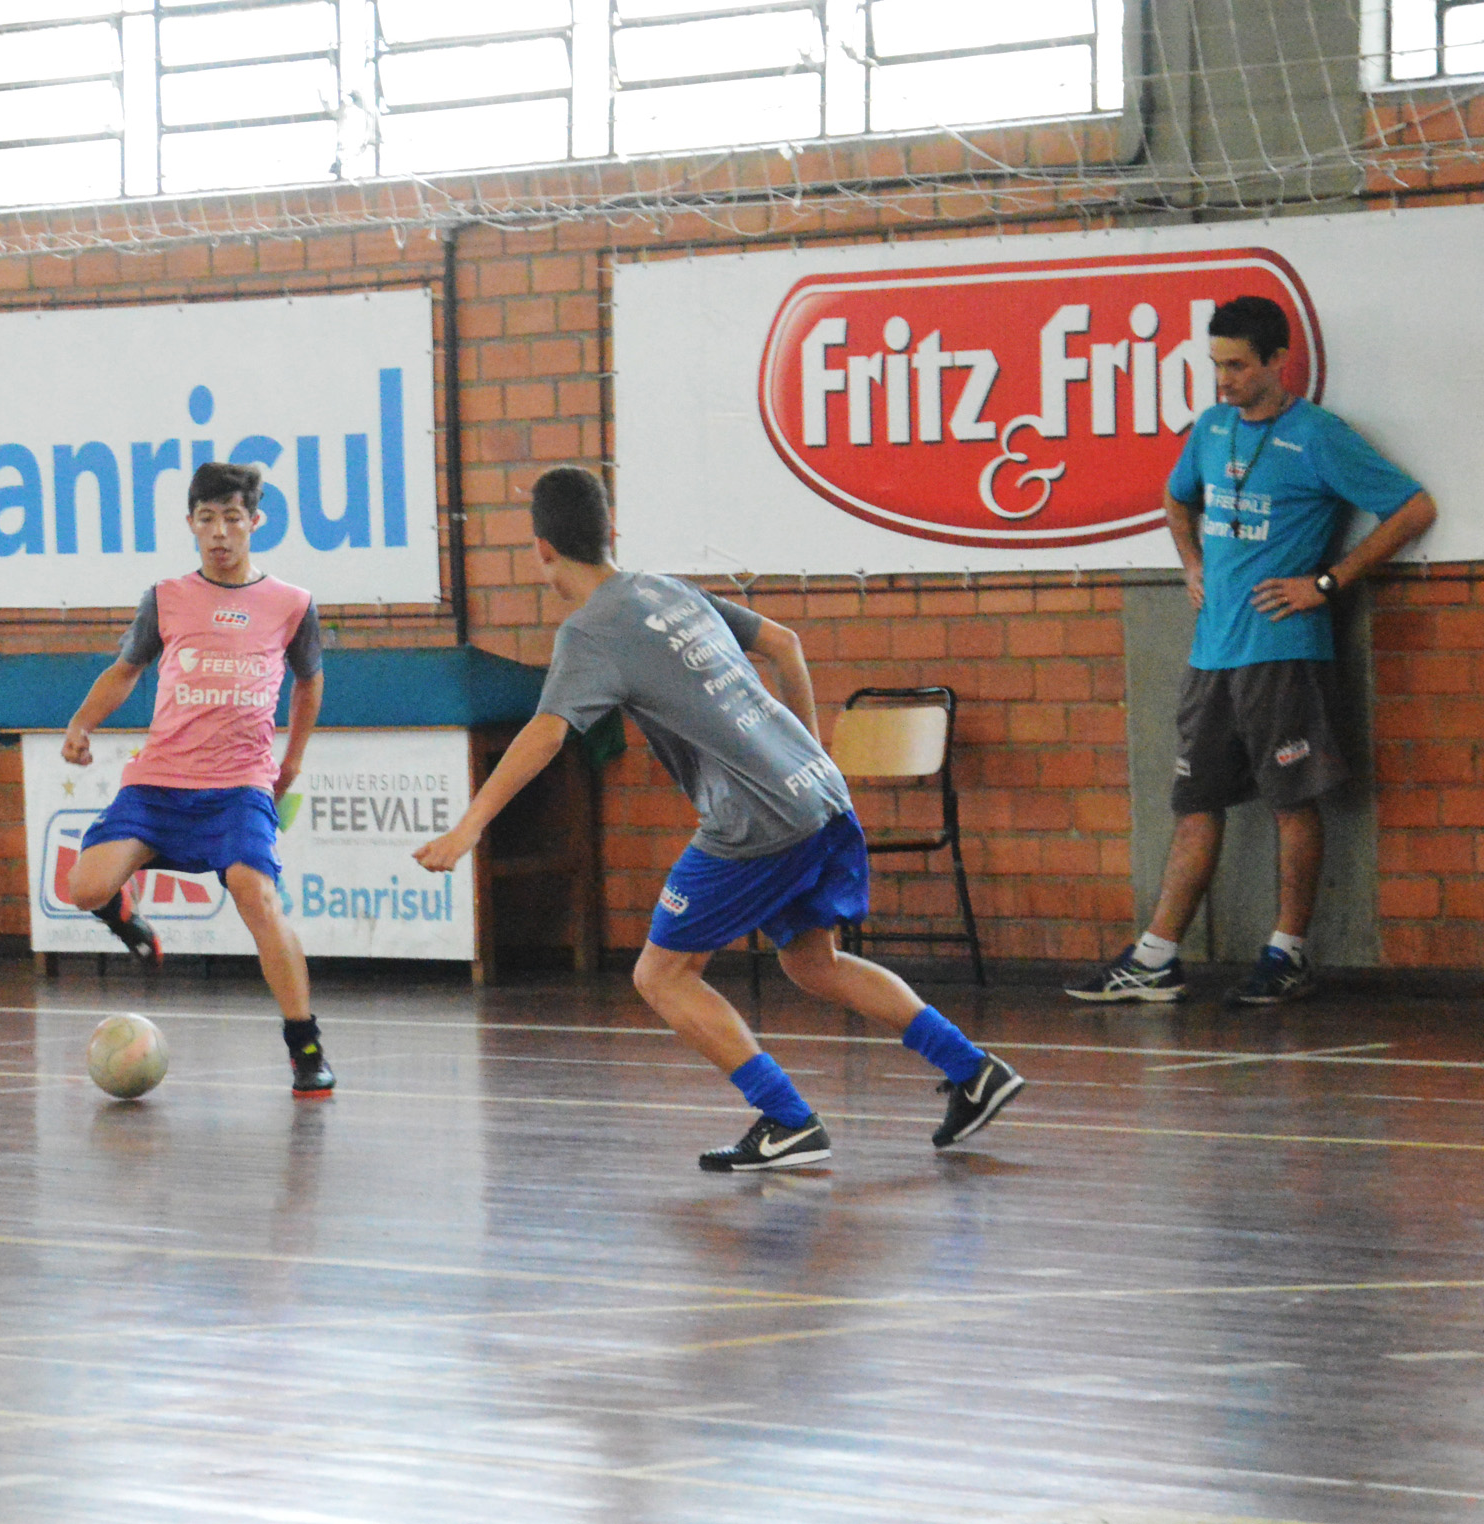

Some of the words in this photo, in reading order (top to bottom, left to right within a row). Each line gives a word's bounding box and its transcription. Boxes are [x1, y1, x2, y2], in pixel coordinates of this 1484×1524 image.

[802, 315, 999, 447] Fritz
[1040, 298, 1218, 438] Frid
[176, 683, 270, 707] Banrisul
[310, 773, 449, 792] UNIVERSIDADE
[311, 796, 450, 832] FEEVALE
[302, 873, 453, 921] Banrisul
